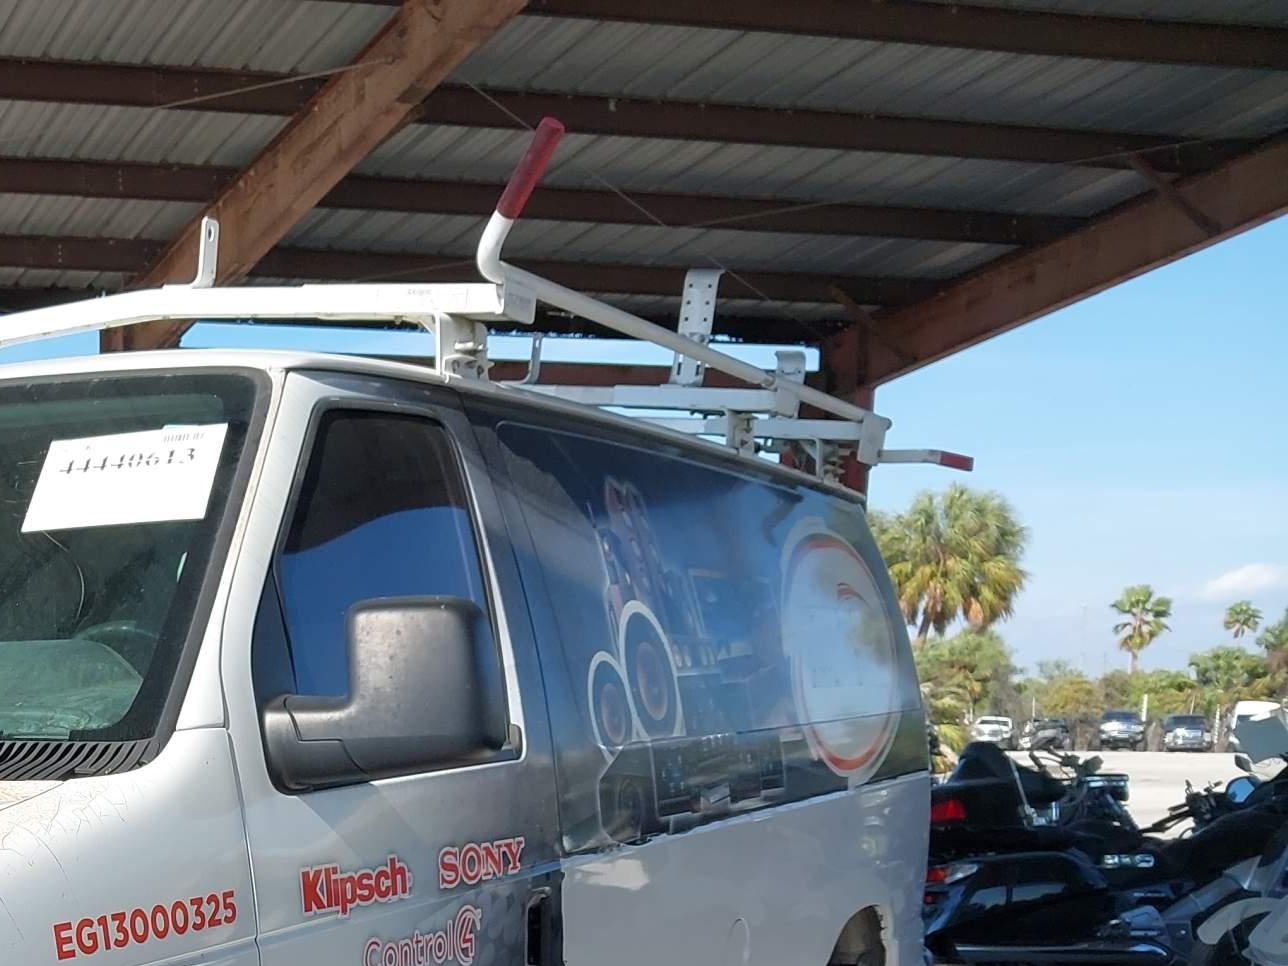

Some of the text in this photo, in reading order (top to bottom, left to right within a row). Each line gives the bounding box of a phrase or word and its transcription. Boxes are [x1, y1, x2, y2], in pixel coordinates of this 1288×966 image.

[301, 856, 409, 917] Klipsch
[439, 838, 524, 888] SONY
[53, 890, 238, 961] EG13000325
